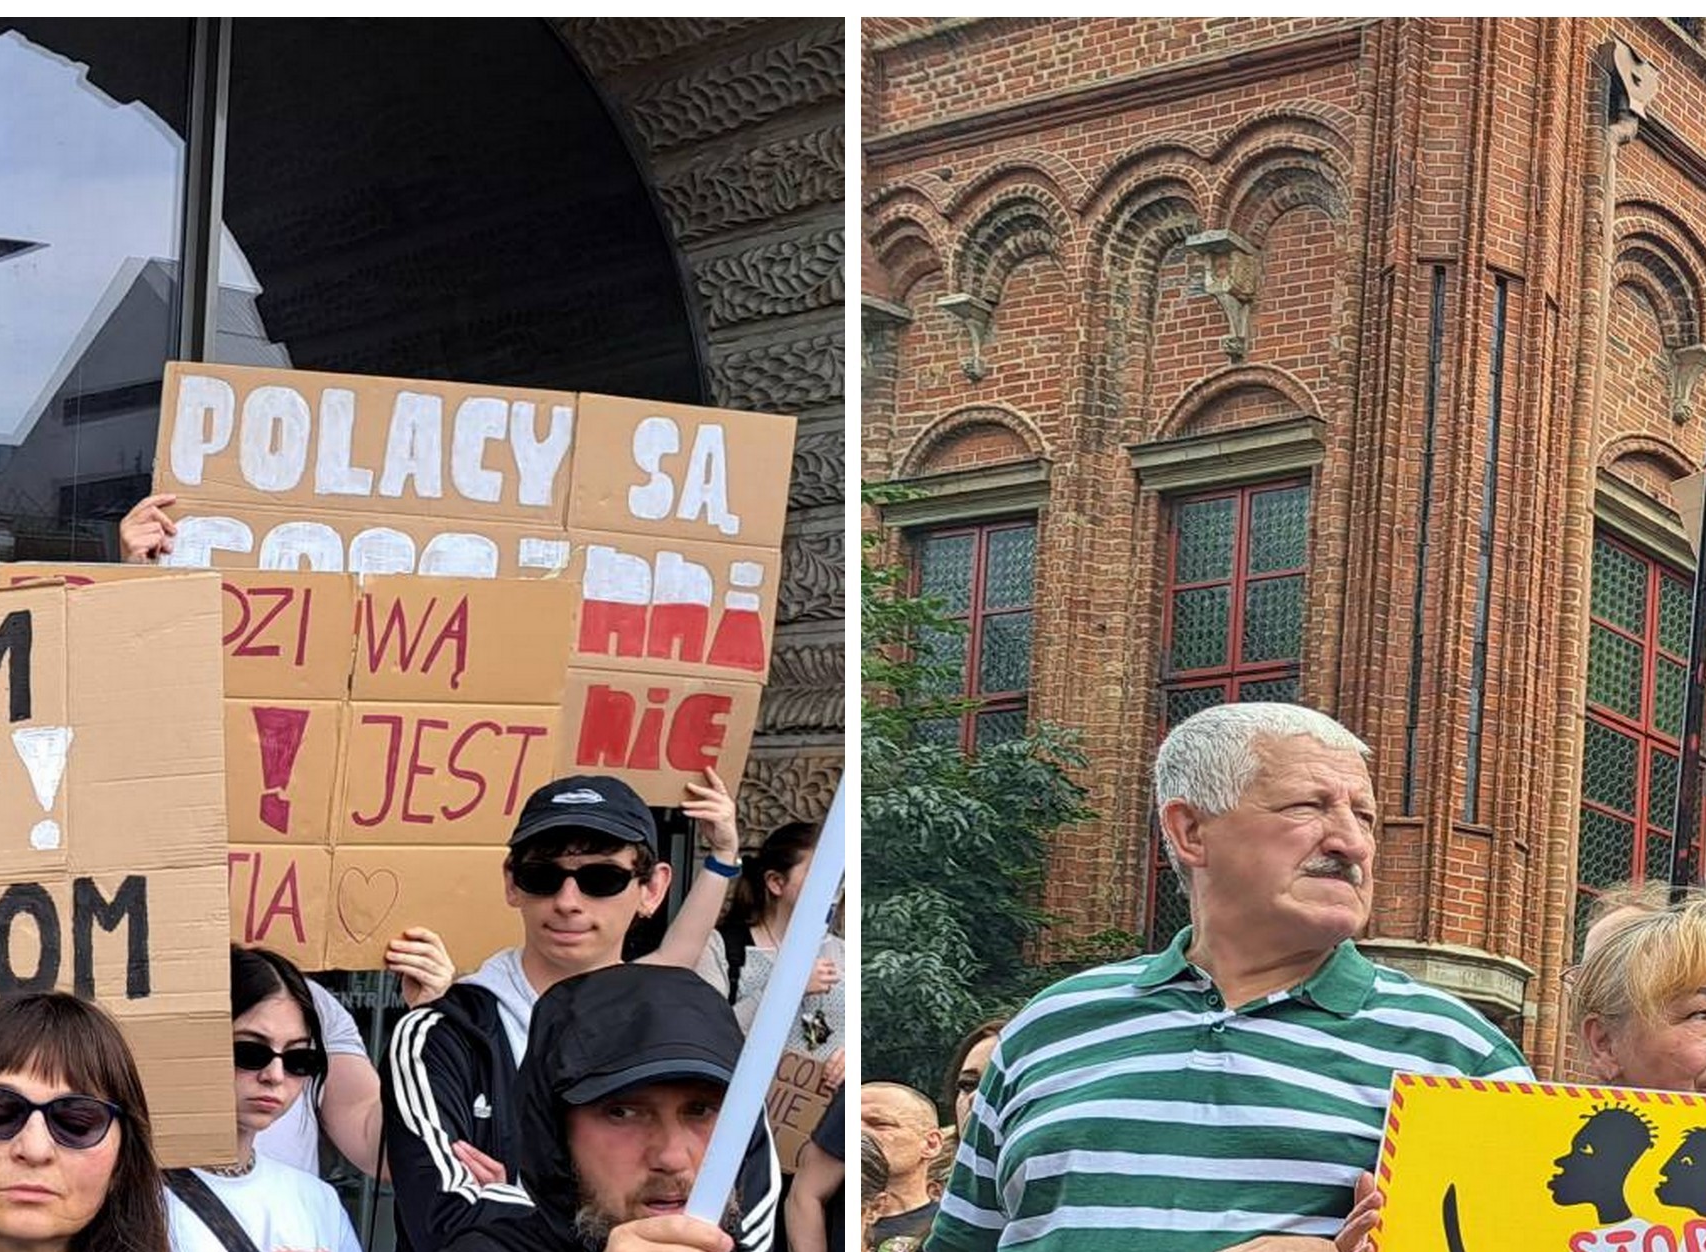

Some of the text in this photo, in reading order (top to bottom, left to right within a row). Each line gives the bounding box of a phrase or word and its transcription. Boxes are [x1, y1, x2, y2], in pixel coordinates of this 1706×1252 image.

[170, 374, 741, 535] POLACY SĄ
[352, 715, 548, 827] JEST
